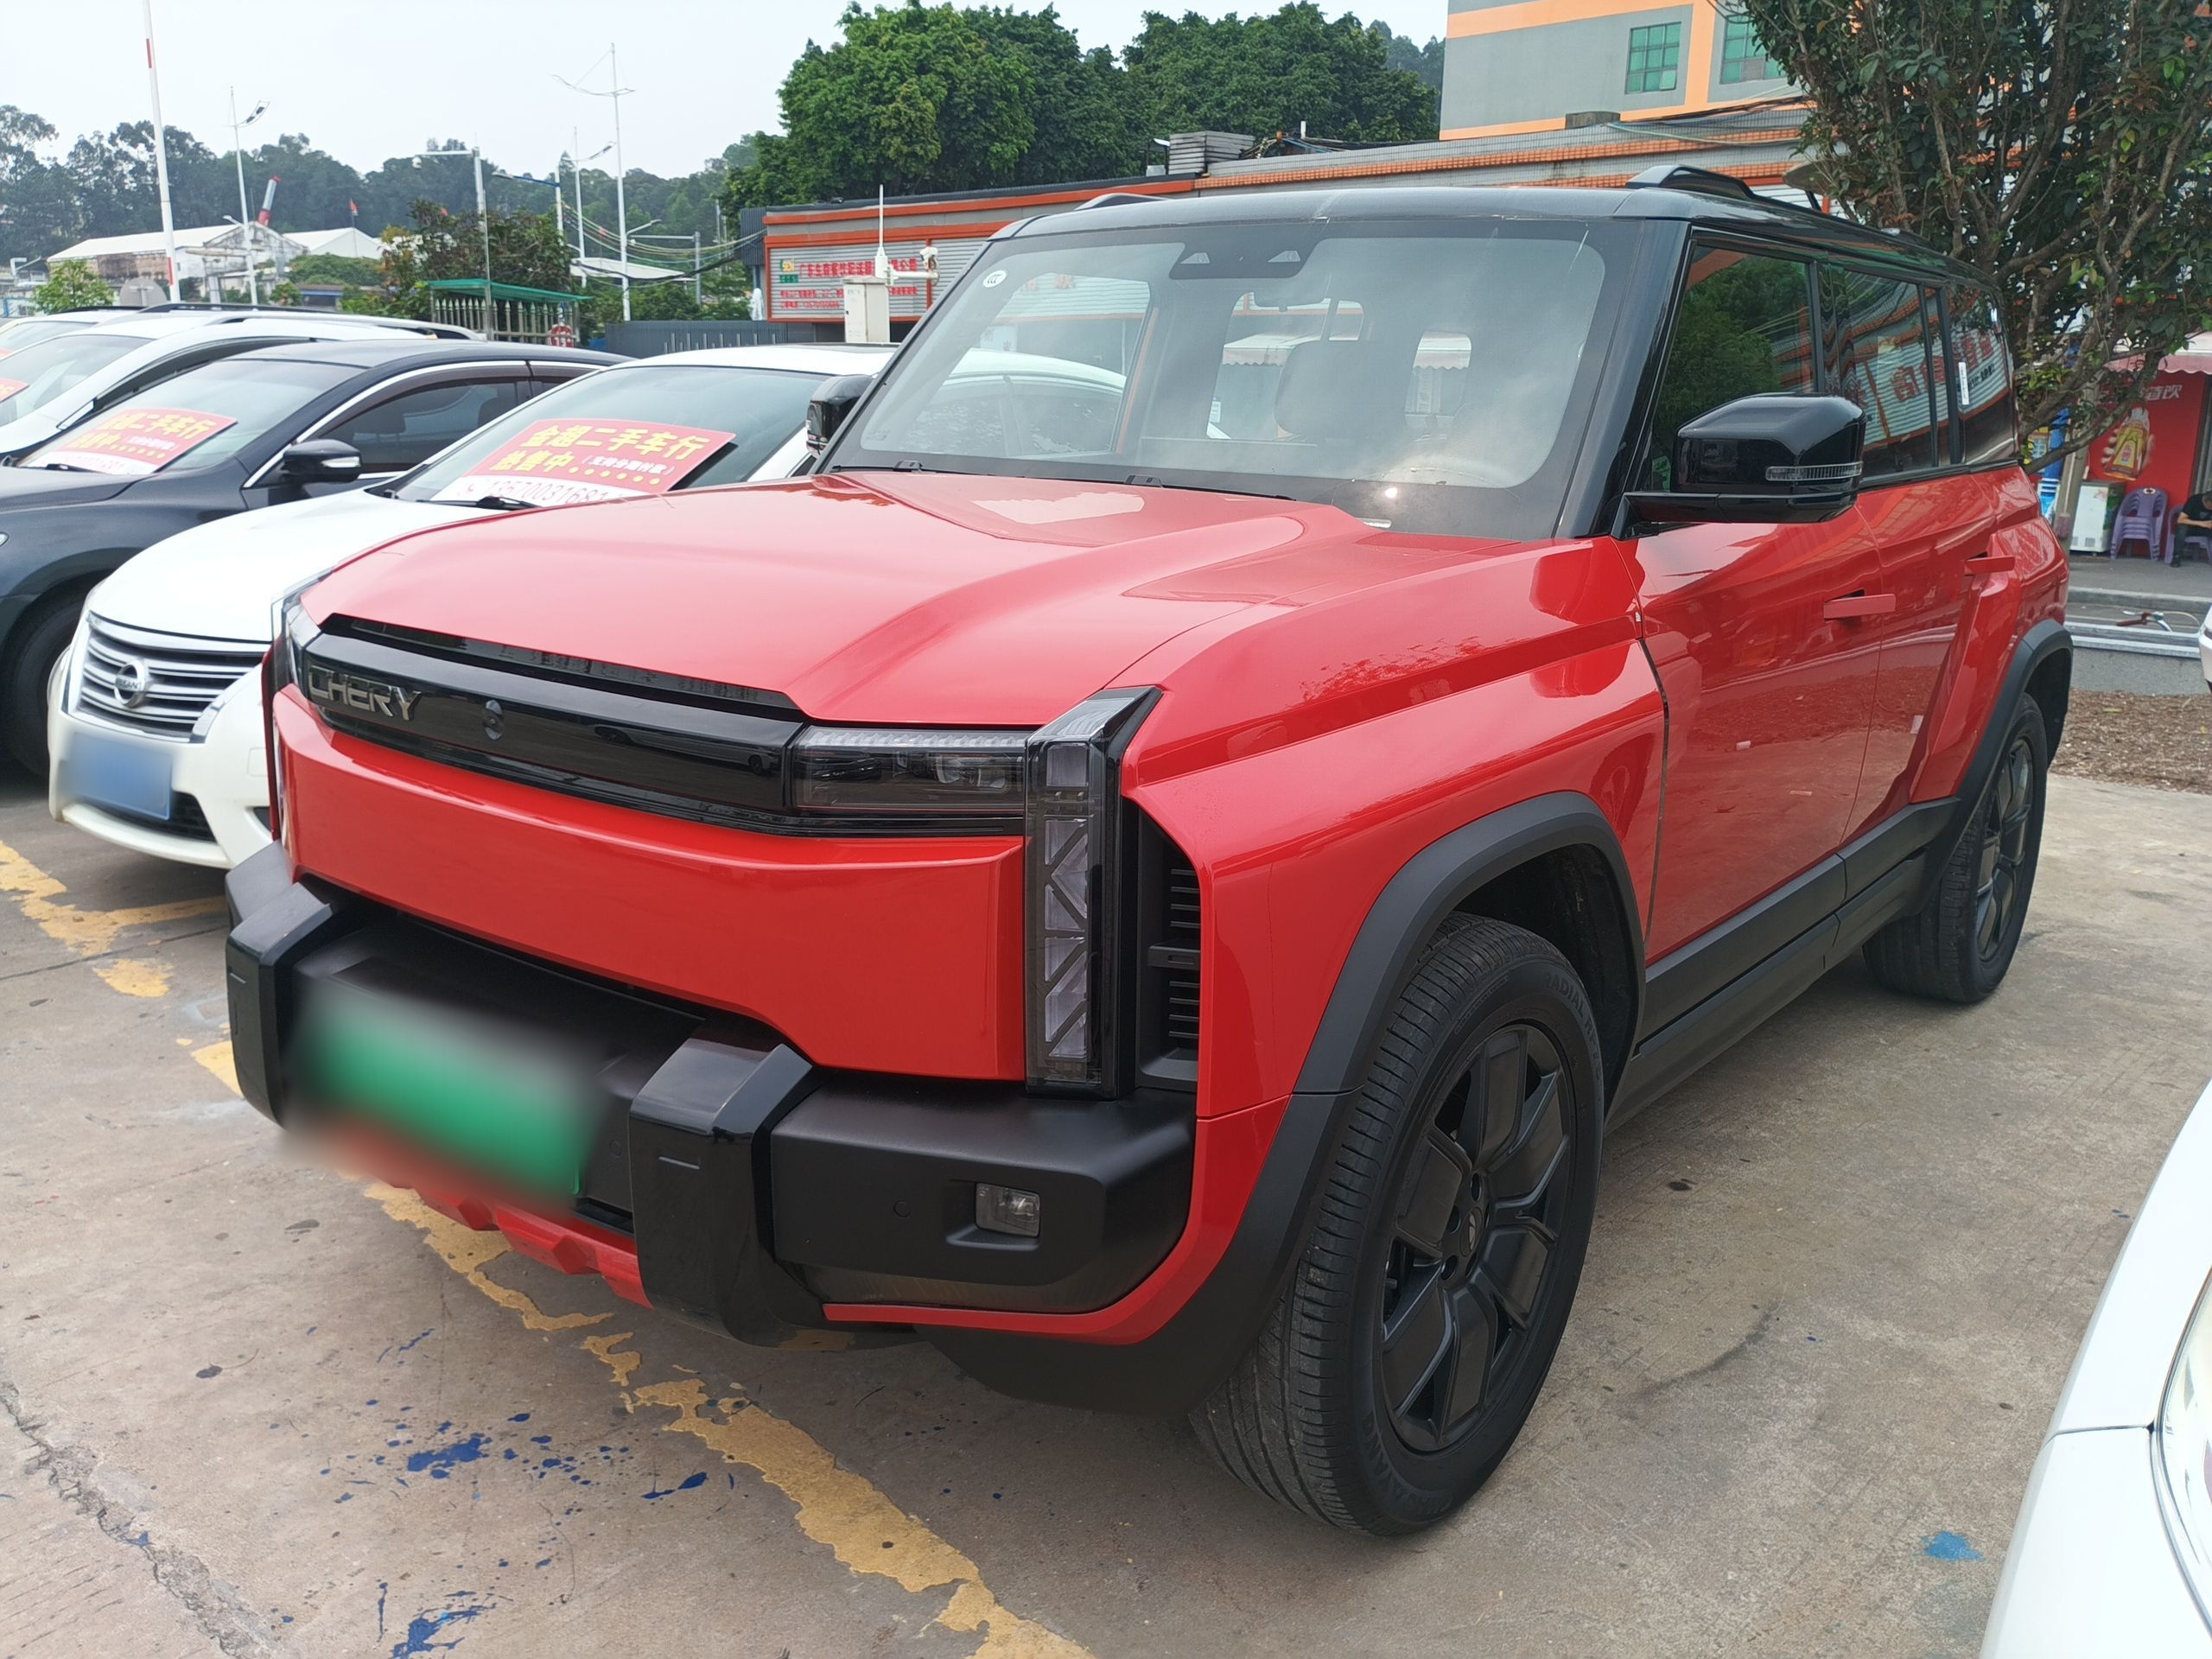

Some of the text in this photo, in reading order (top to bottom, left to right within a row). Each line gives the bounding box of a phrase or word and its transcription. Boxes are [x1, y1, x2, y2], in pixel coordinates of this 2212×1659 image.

[519, 424, 711, 460] 金超二手车行
[308, 664, 423, 721] CHERY
